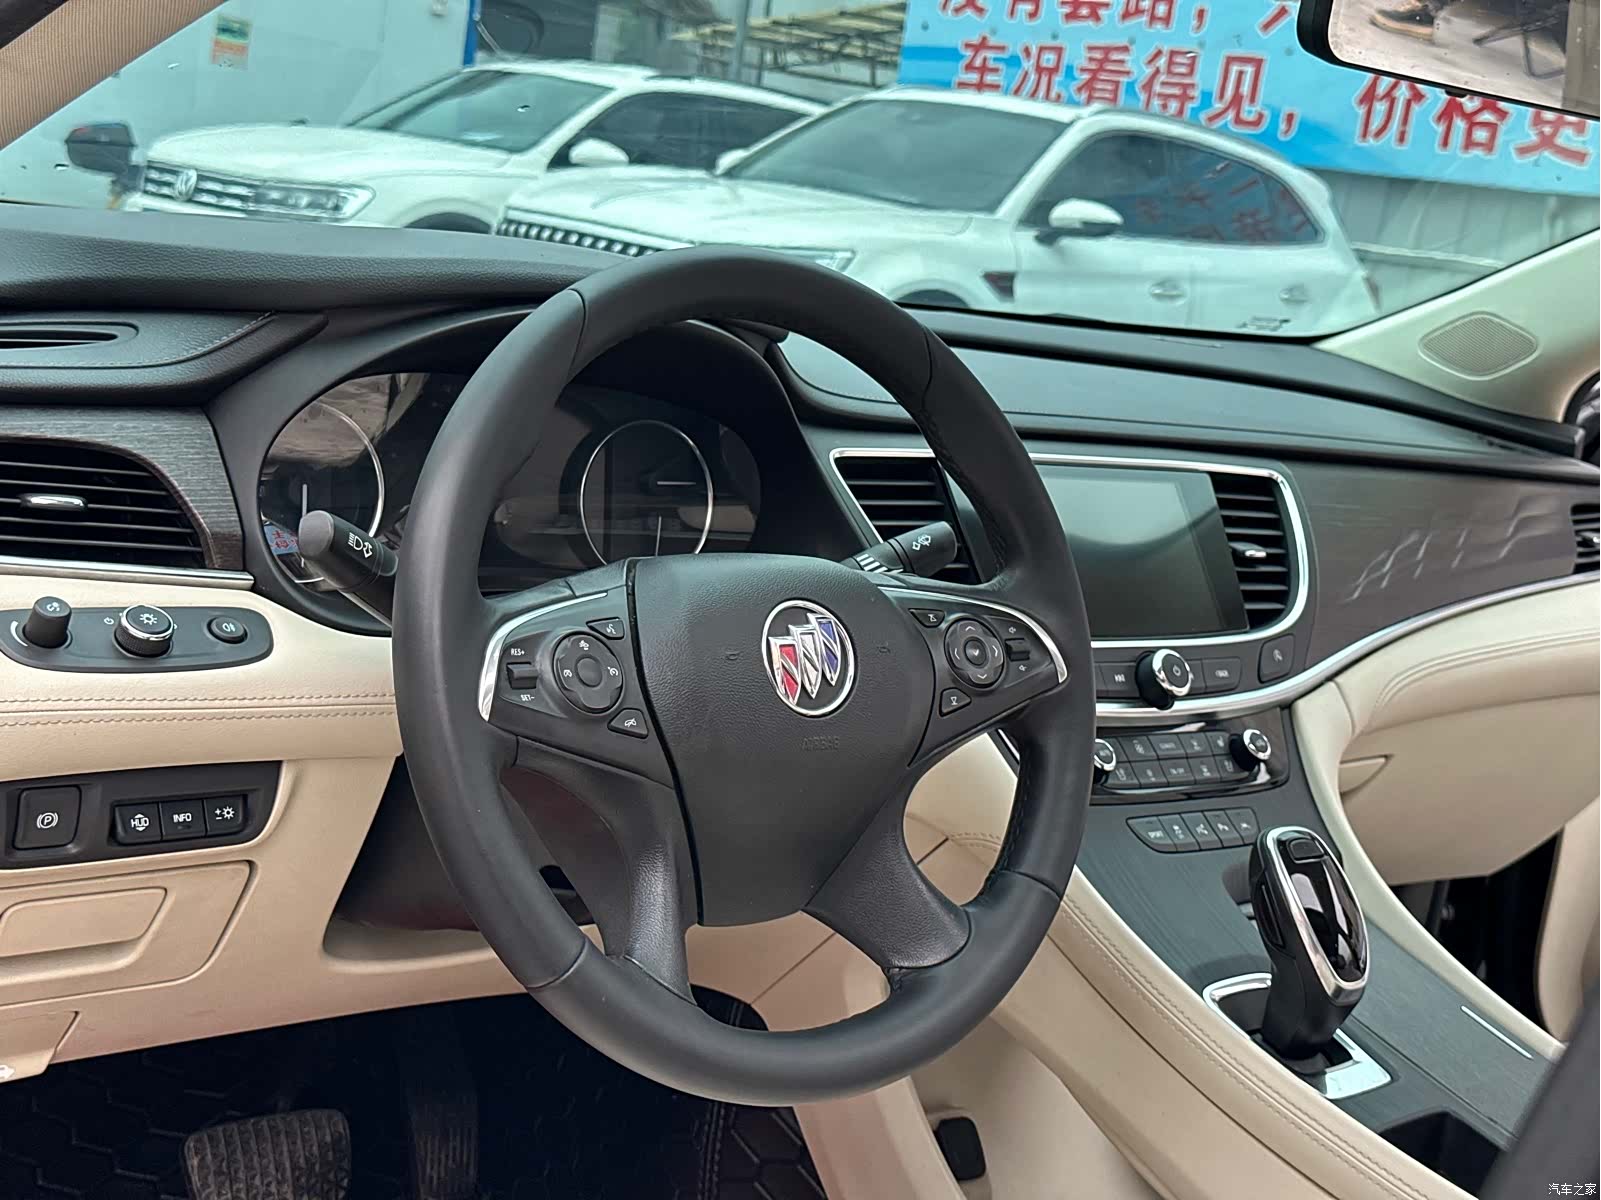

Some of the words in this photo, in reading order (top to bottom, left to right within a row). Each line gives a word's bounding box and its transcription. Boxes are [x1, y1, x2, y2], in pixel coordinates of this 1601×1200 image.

[511, 648, 525, 656] RES+
[131, 817, 149, 828] HUD
[173, 813, 192, 823] INFO
